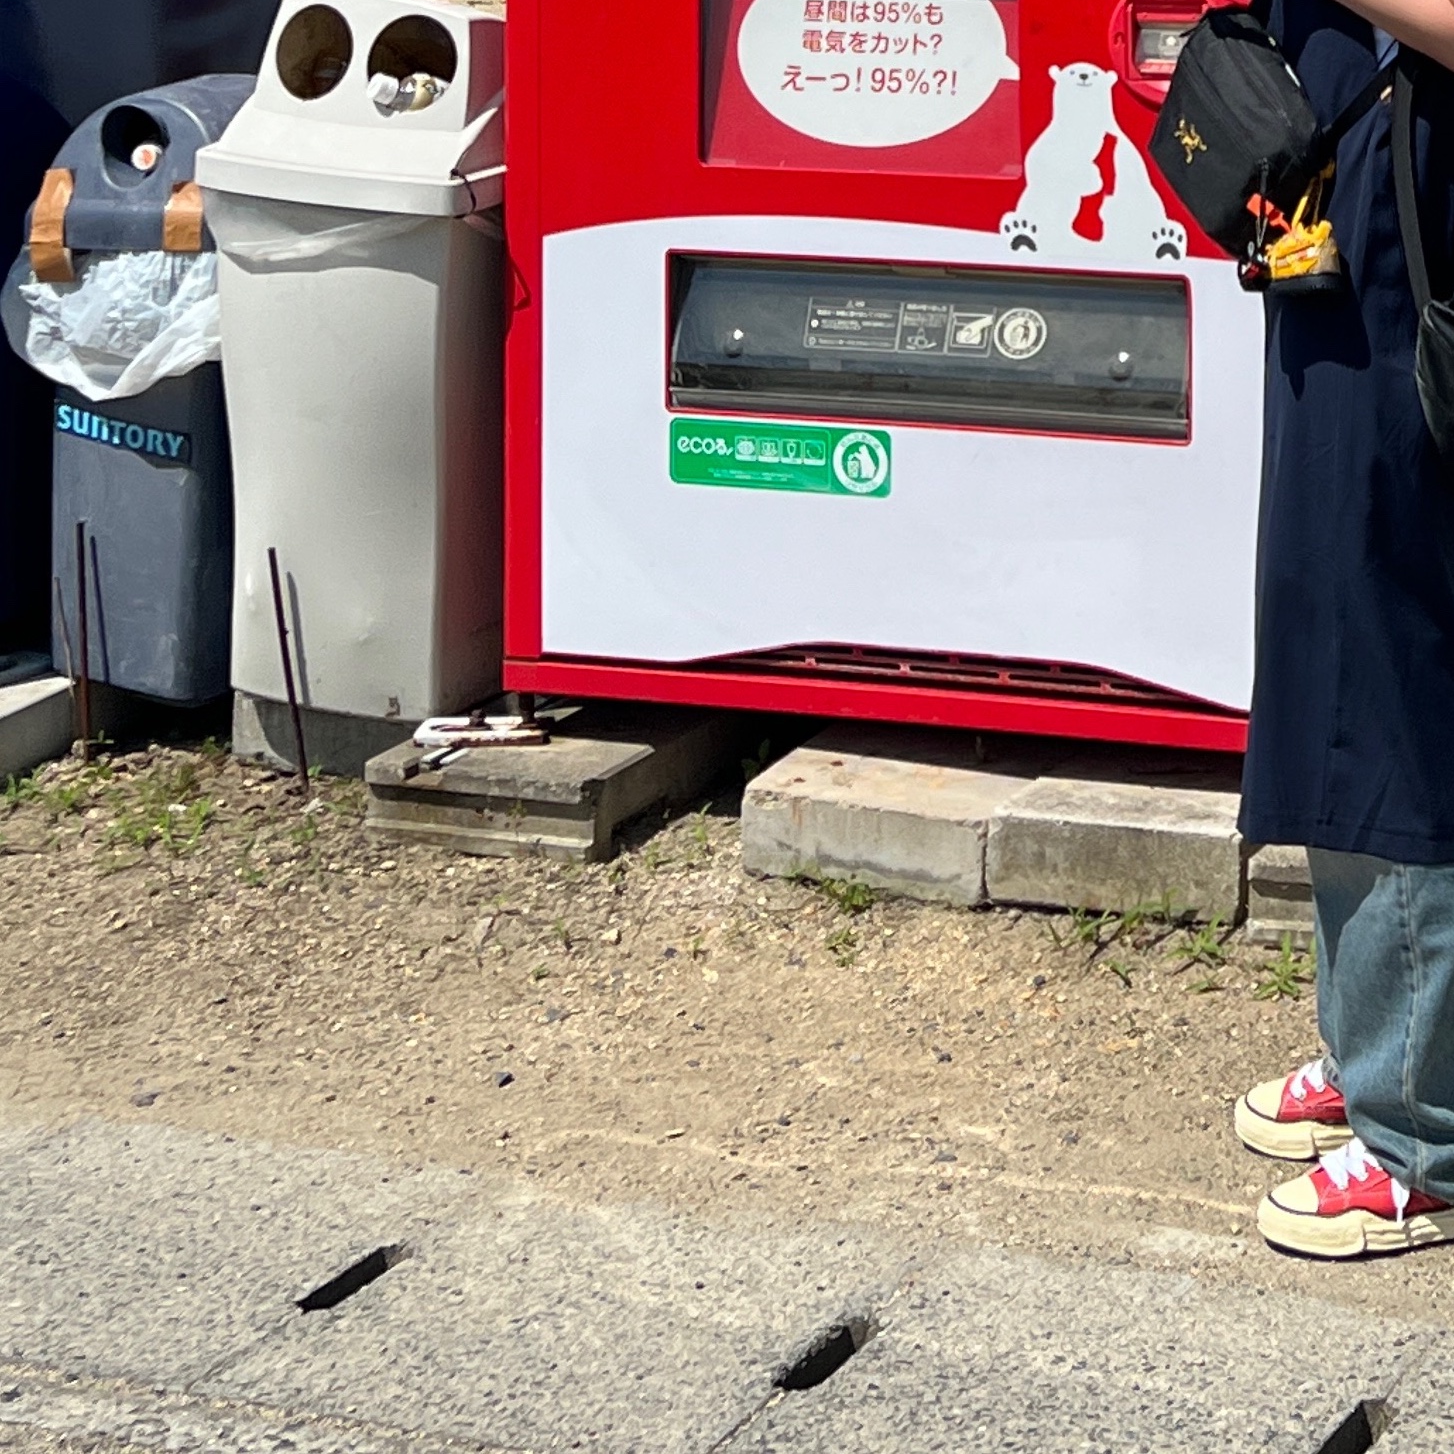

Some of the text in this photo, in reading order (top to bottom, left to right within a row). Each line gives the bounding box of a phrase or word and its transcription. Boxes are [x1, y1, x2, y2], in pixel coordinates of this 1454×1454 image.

[801, 29, 943, 56] 電気をカット?
